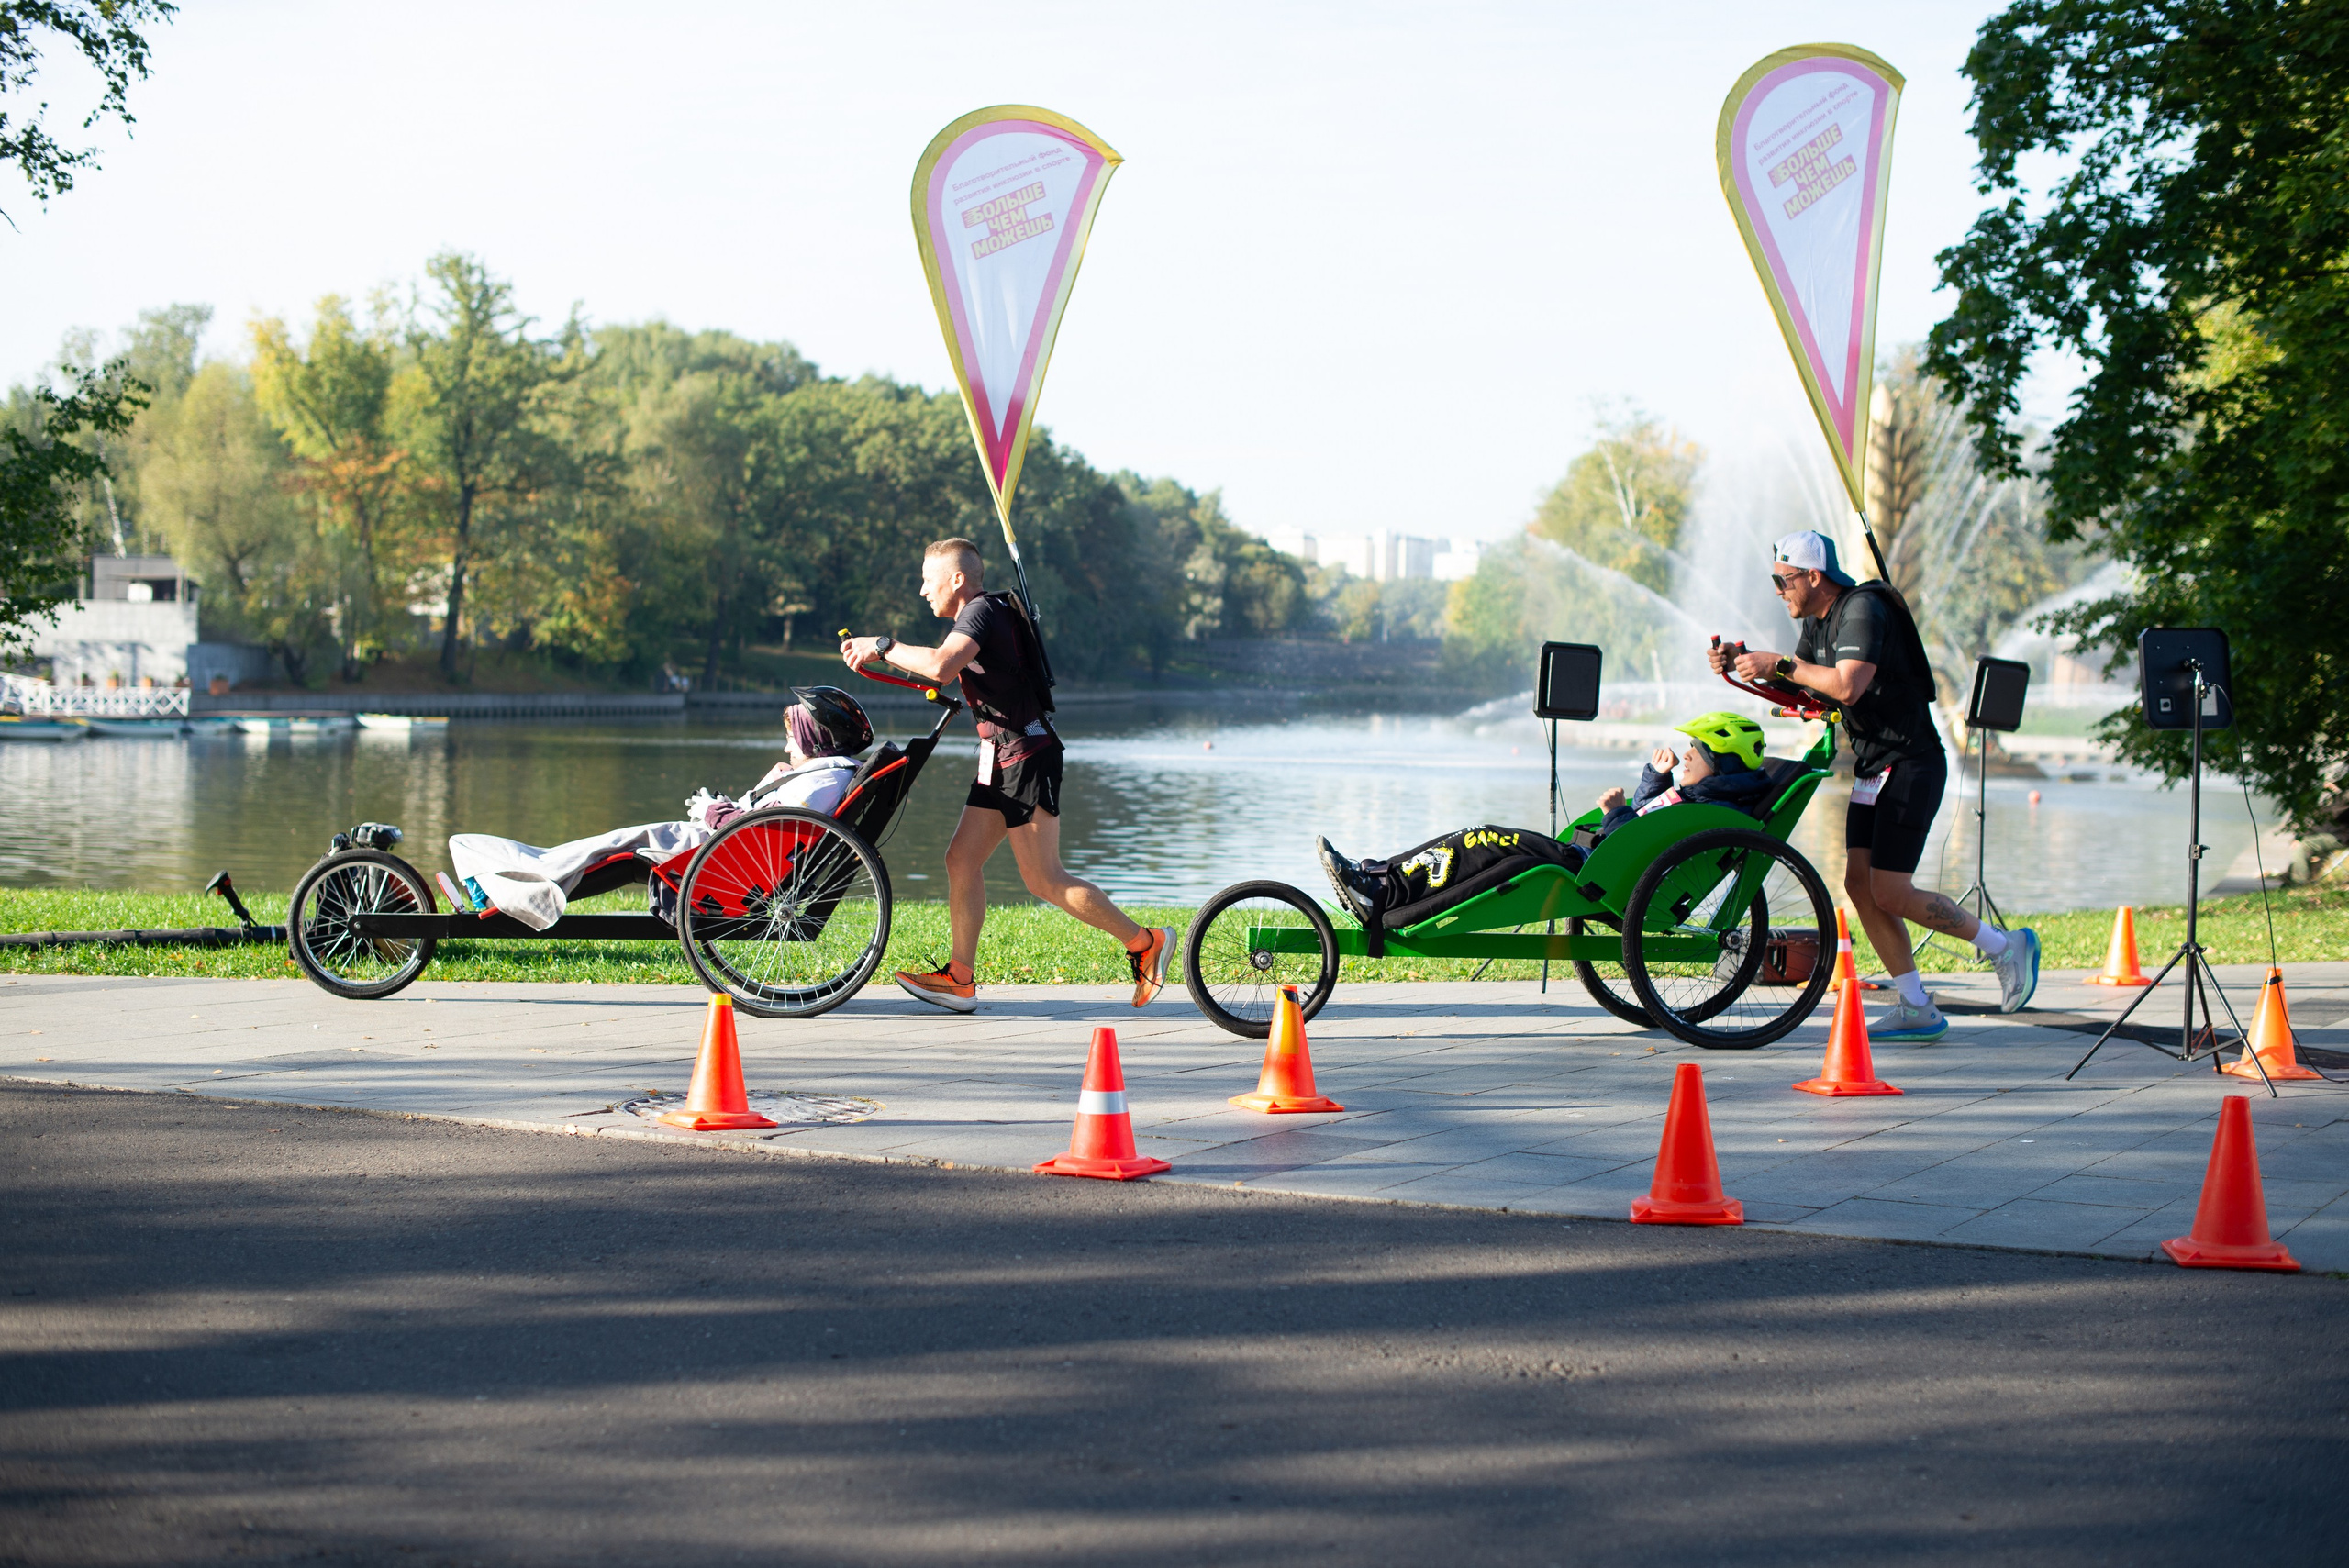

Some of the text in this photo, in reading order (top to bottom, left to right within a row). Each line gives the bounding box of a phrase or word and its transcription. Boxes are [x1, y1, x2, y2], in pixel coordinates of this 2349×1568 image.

[1753, 83, 1849, 151] Благотворительный фонд
[1758, 139, 1791, 166] развития
[1791, 113, 1827, 140] инклюзии
[1833, 91, 1858, 111] спорте
[952, 147, 1063, 191] Благотворительный фонд
[1770, 123, 1842, 186] БОЛЬШЕ
[1794, 153, 1831, 186] ЧЕМ
[954, 185, 991, 206] развития
[993, 169, 1033, 189] инклюзии
[1041, 156, 1071, 170] спорте
[963, 182, 1045, 225] БОЛЬШЕ
[1785, 159, 1855, 219] МОЖЕШЬ
[973, 216, 1053, 259] МОЖЕШЬ
[987, 206, 1027, 232] ЧЕМ
